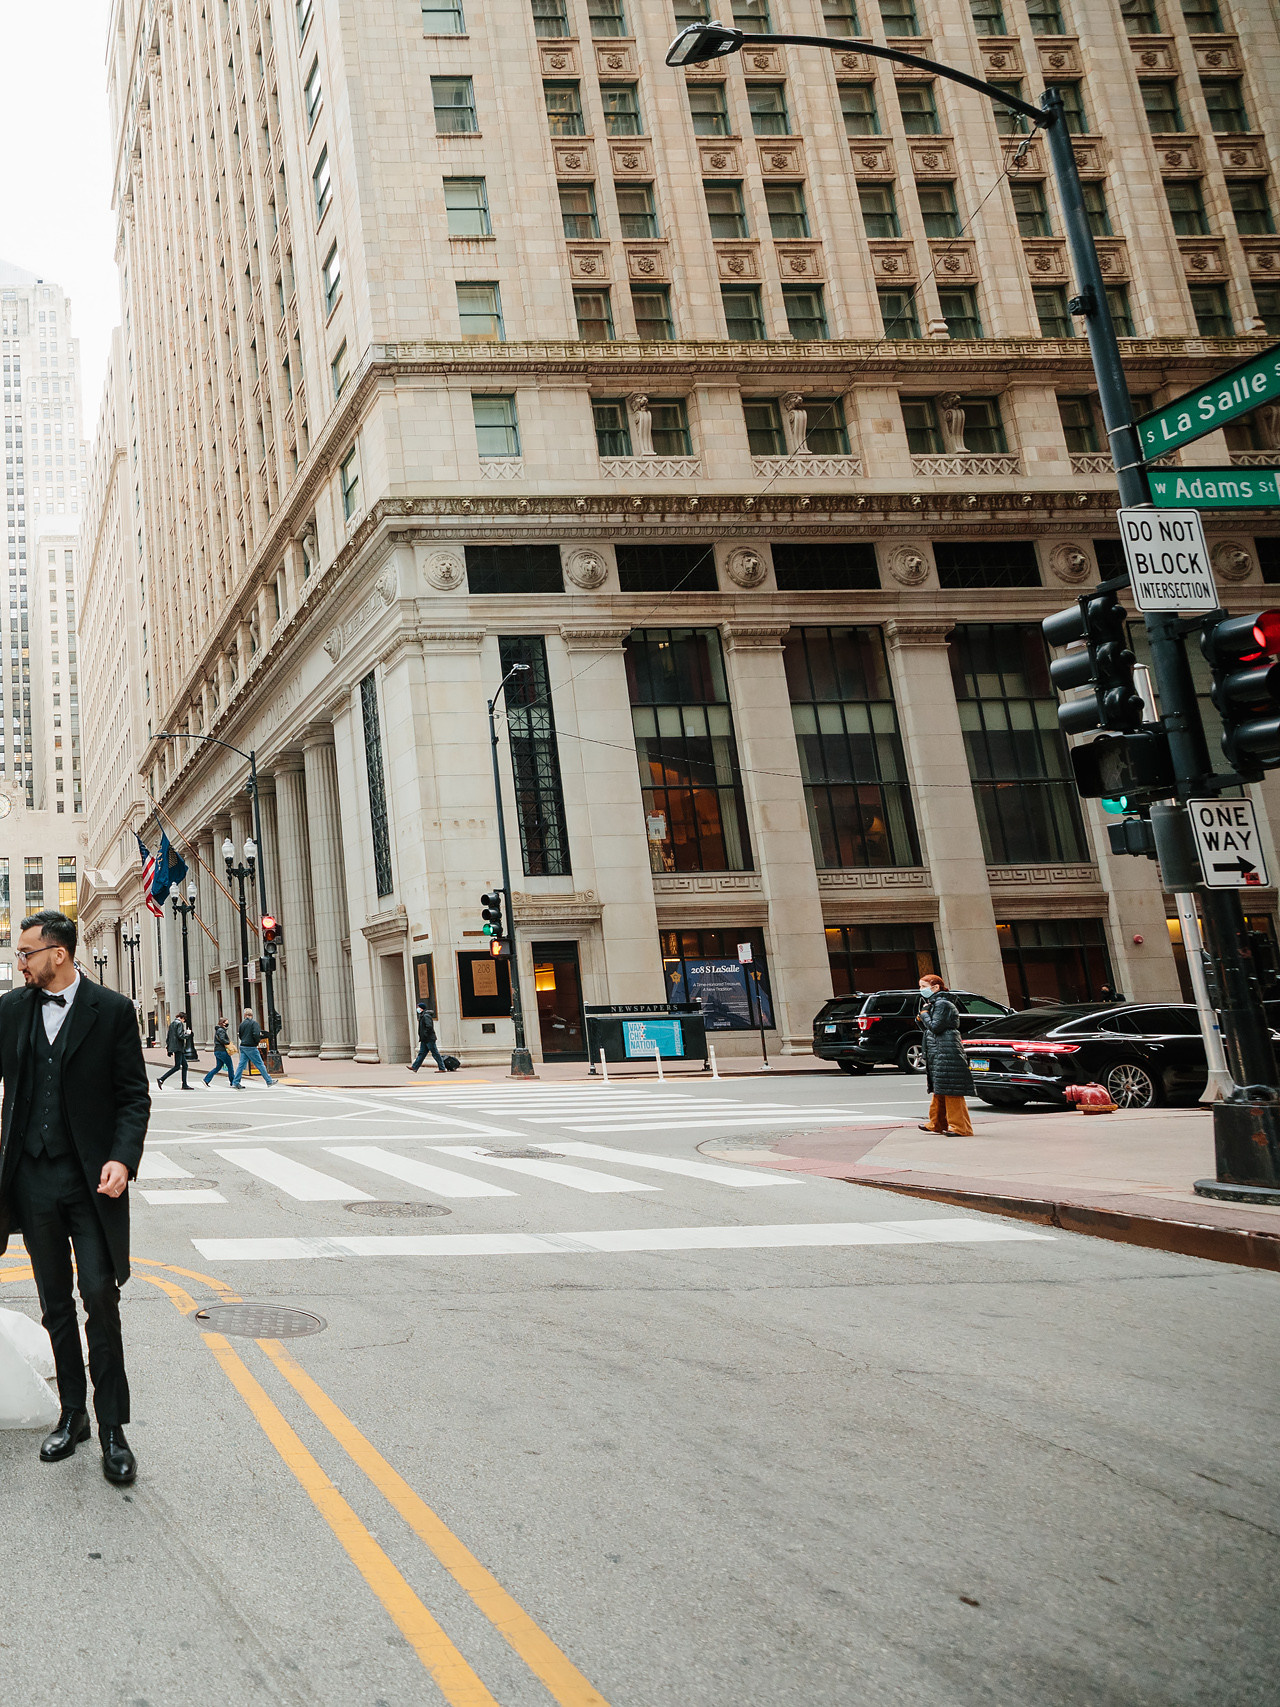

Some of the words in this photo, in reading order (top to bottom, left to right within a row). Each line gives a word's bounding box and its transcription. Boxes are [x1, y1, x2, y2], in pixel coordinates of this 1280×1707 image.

[1147, 430, 1155, 443] S
[1160, 412, 1192, 441] La
[1197, 372, 1268, 421] Salle
[1175, 477, 1253, 499] Adams
[1258, 481, 1275, 493] St
[1127, 521, 1153, 542] DO
[1159, 521, 1194, 542] NOT
[1135, 552, 1203, 575] BLOCK
[1140, 582, 1211, 599] INTERSECTION
[1200, 806, 1249, 827] ONE
[1202, 830, 1252, 851] WAY
[477, 964, 491, 974] 208
[691, 966, 705, 974] 208
[705, 965, 711, 974] S
[711, 964, 740, 973] LaSalle
[611, 1004, 678, 1013] NEWSPAPERS
[630, 1041, 656, 1049] NATION
